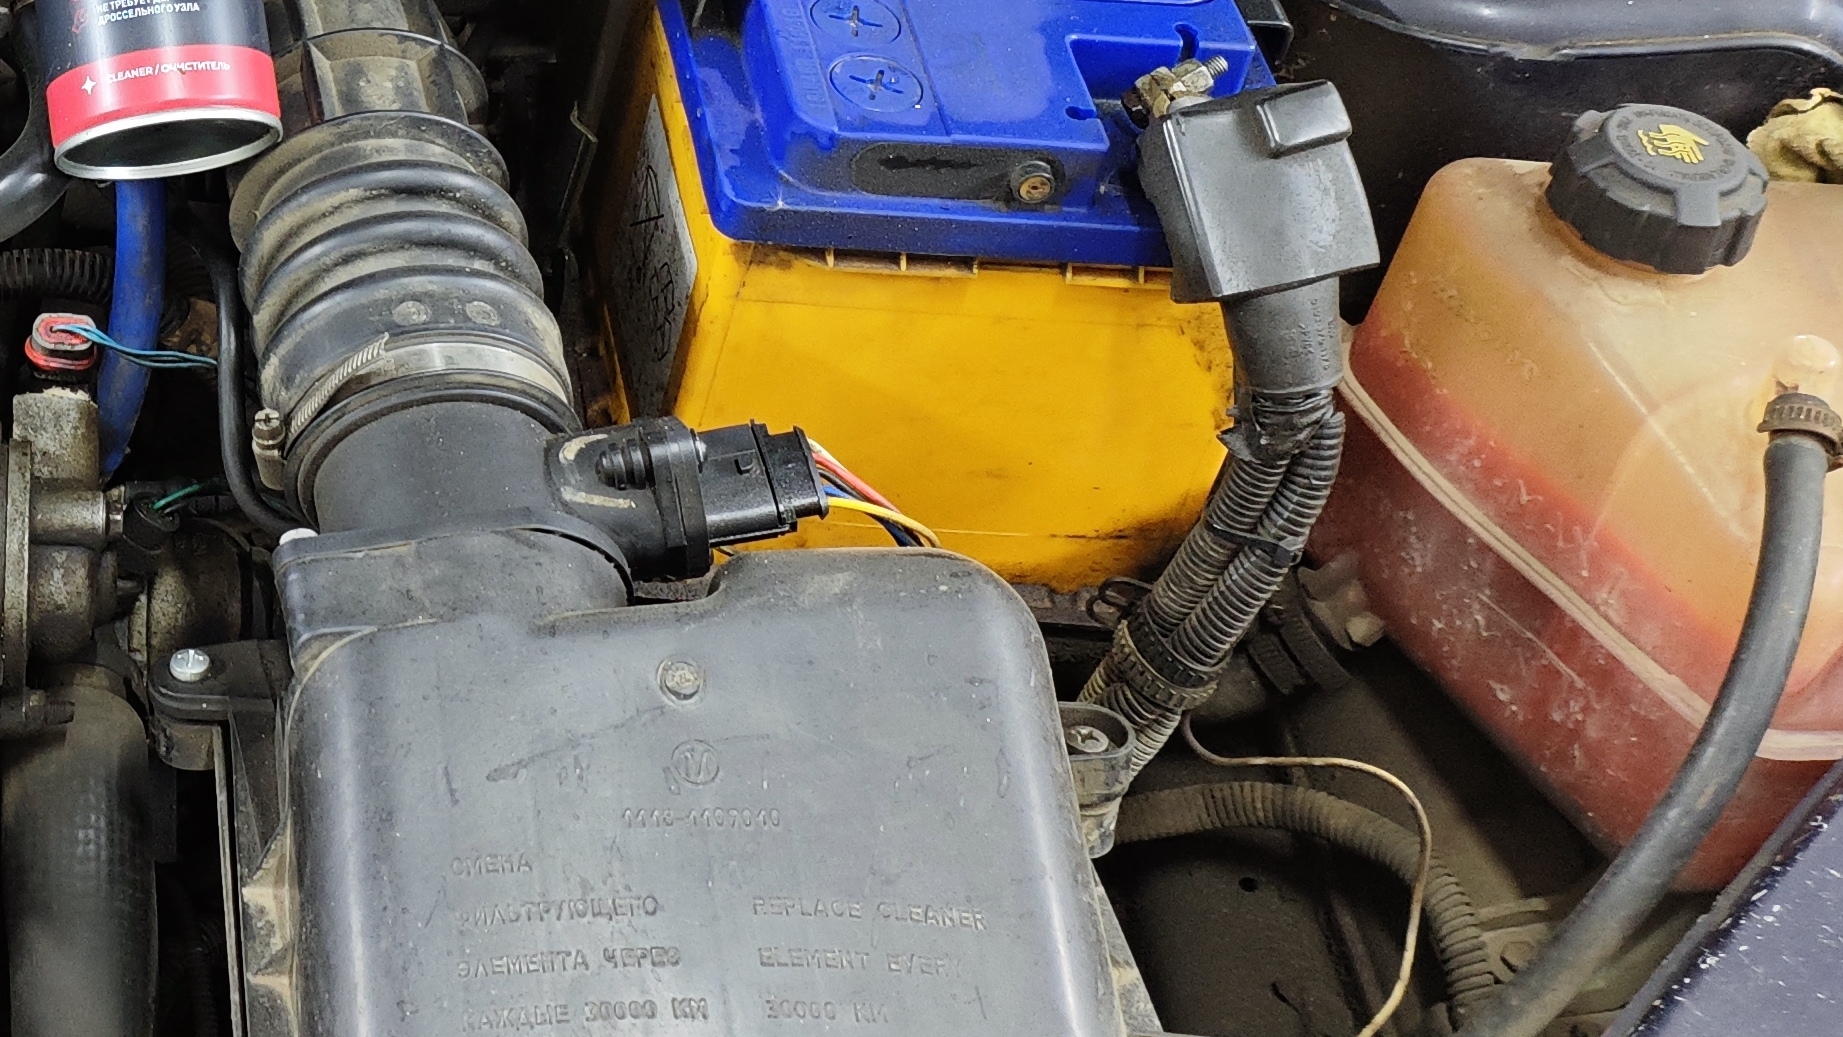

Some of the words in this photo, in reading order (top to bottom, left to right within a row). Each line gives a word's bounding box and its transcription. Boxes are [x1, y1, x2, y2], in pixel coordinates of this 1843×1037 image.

[95, 3, 109, 14] НЕ
[98, 4, 174, 27] ДРОССЕЛЬНОГО
[174, 2, 201, 13] УЗЛА
[106, 65, 153, 85] CLEANER
[160, 61, 231, 74] ОЧИСТИТЕЛЬ
[451, 853, 533, 877] СМЕНА
[752, 896, 863, 919] REPLACE
[876, 900, 988, 931] CLEANER
[457, 949, 590, 979] ЭЛЕМЕНТА
[602, 946, 682, 969] ЧЕРЕЗ
[757, 946, 870, 970] ELEMENT
[462, 1003, 572, 1032] КАЖДЫЕ
[584, 999, 658, 1023] 30000
[765, 997, 837, 1021] 30000
